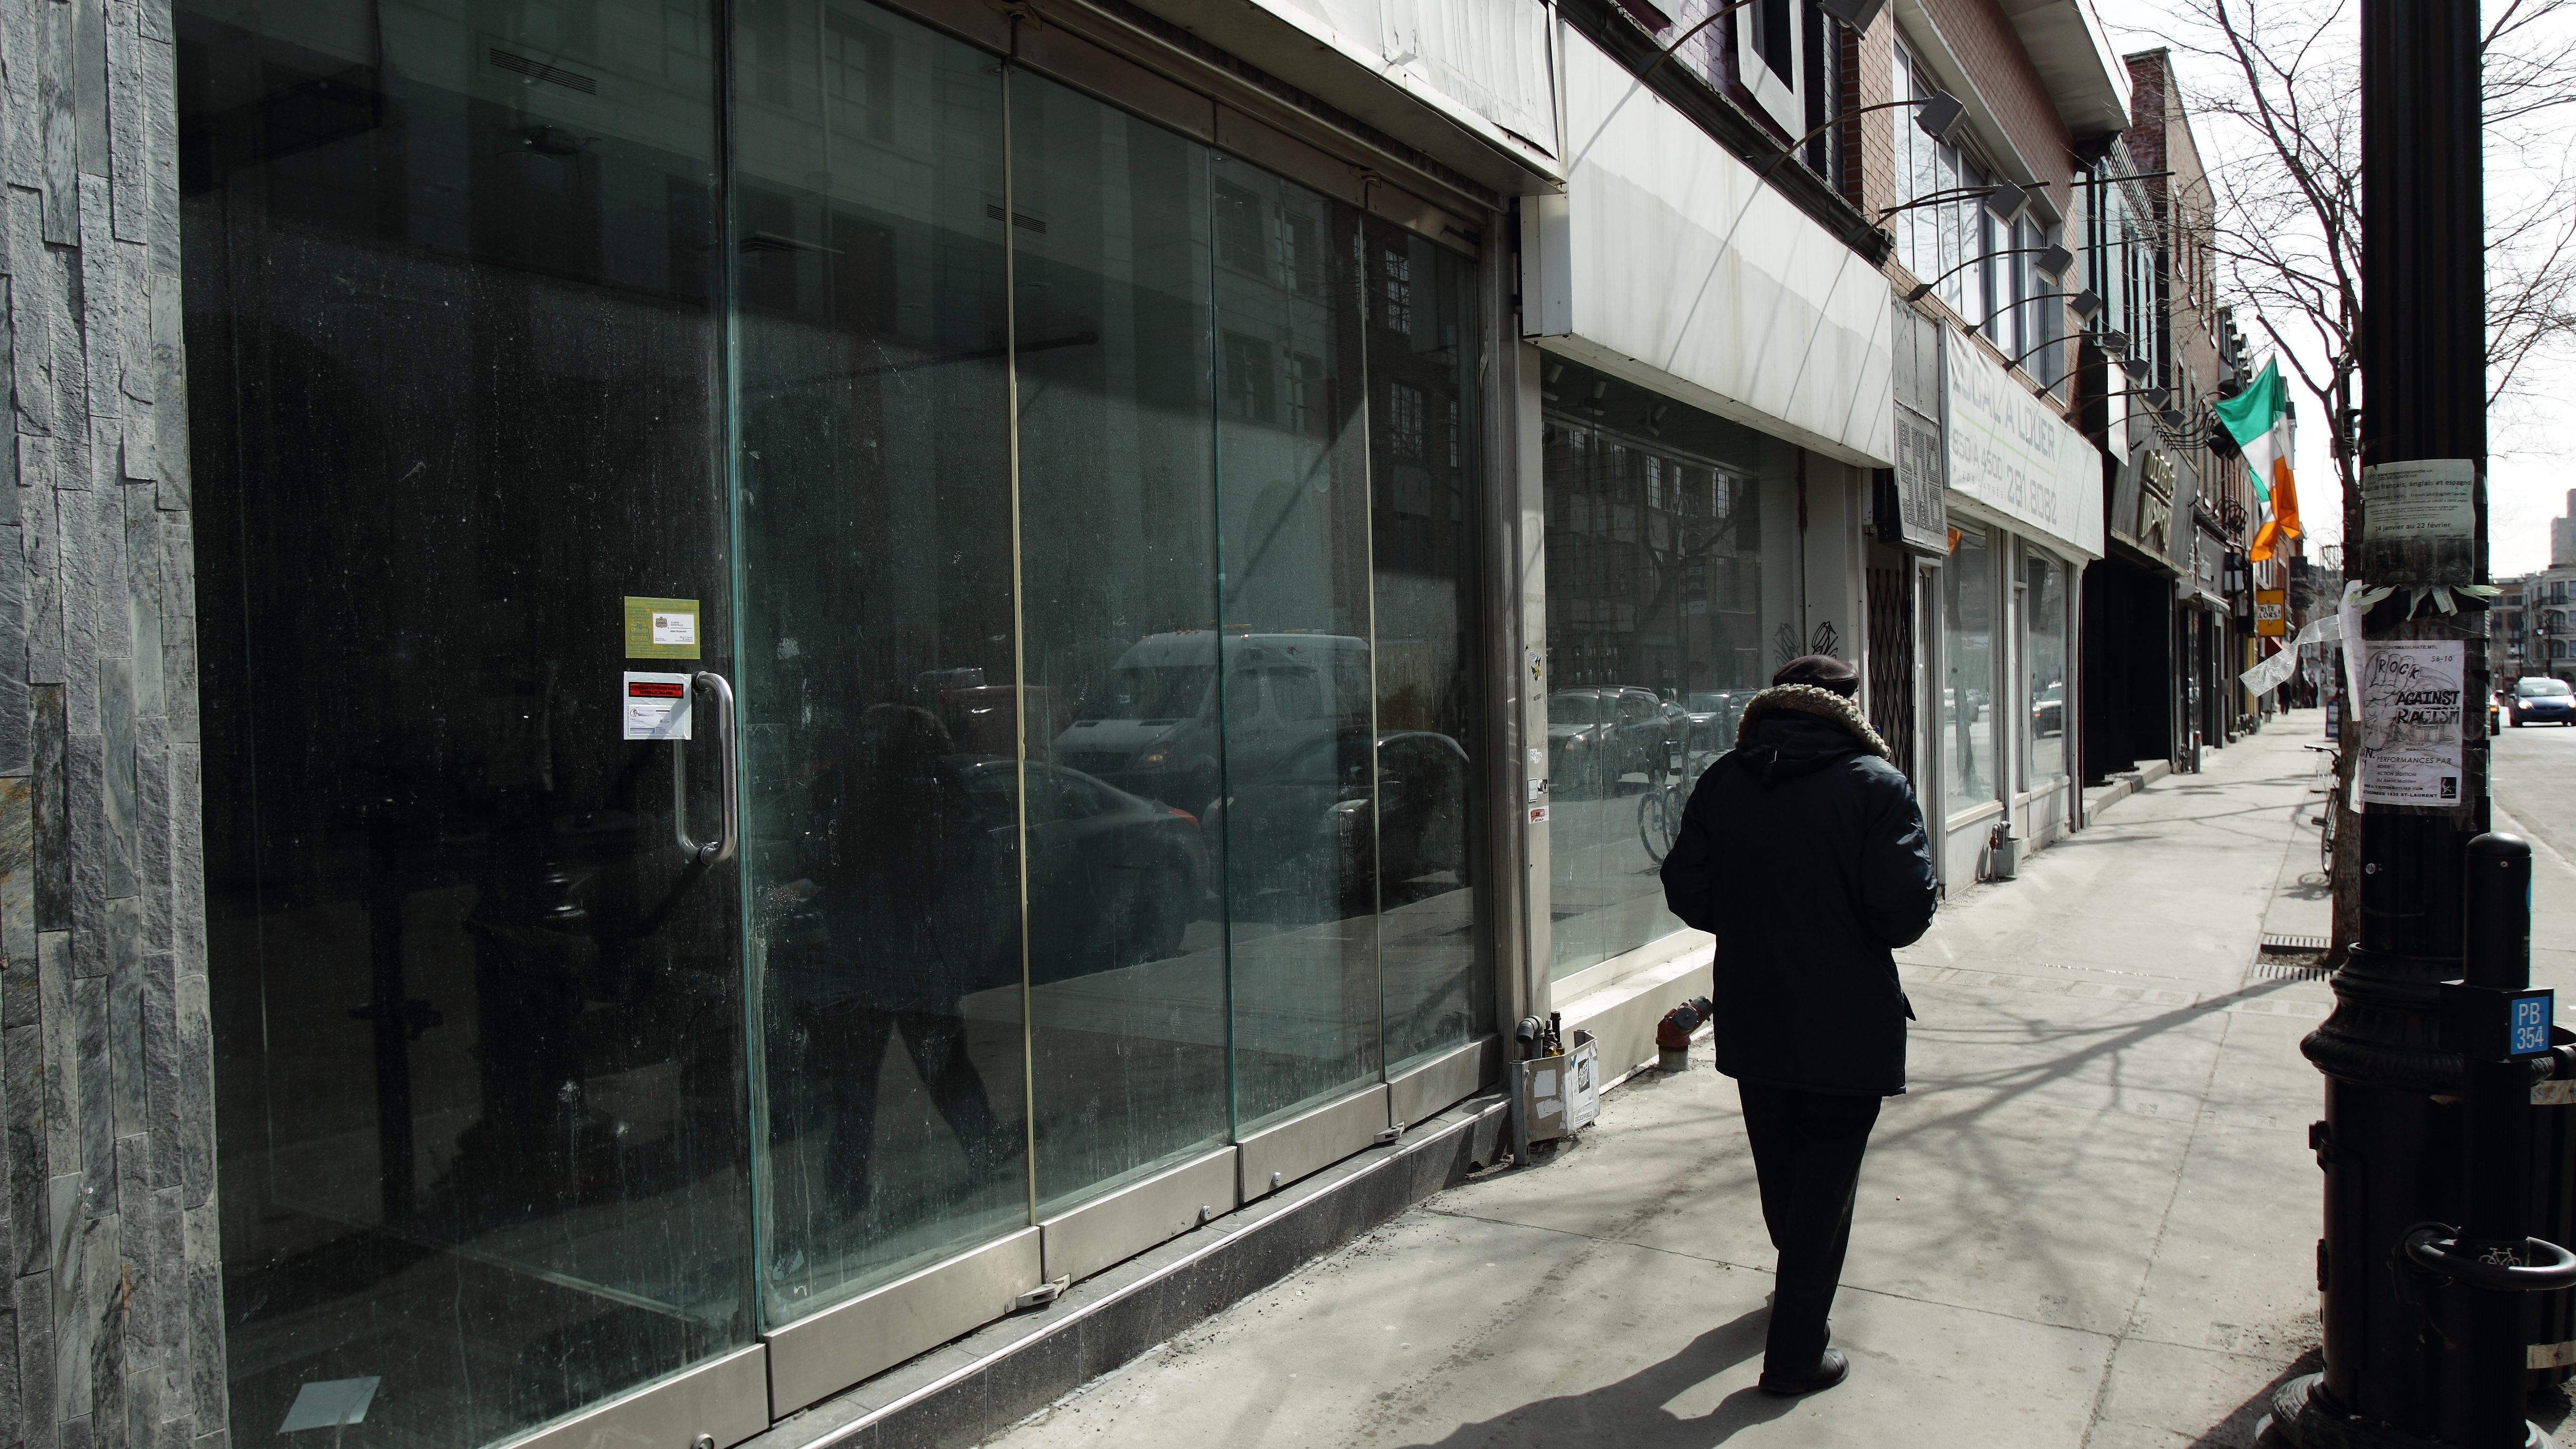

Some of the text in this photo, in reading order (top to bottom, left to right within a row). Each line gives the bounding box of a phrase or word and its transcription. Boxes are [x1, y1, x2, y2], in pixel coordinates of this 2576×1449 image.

[1953, 351, 2001, 424] LOCAL
[2018, 398, 2056, 462] LOUER
[1953, 428, 1970, 464] 850
[1981, 447, 2003, 481] 4500
[2378, 659, 2420, 679] ROCK
[2394, 689, 2460, 705] AGAINST
[2396, 707, 2459, 724] RACISM
[2518, 1002, 2540, 1025] PB
[2517, 1026, 2543, 1050] 354
